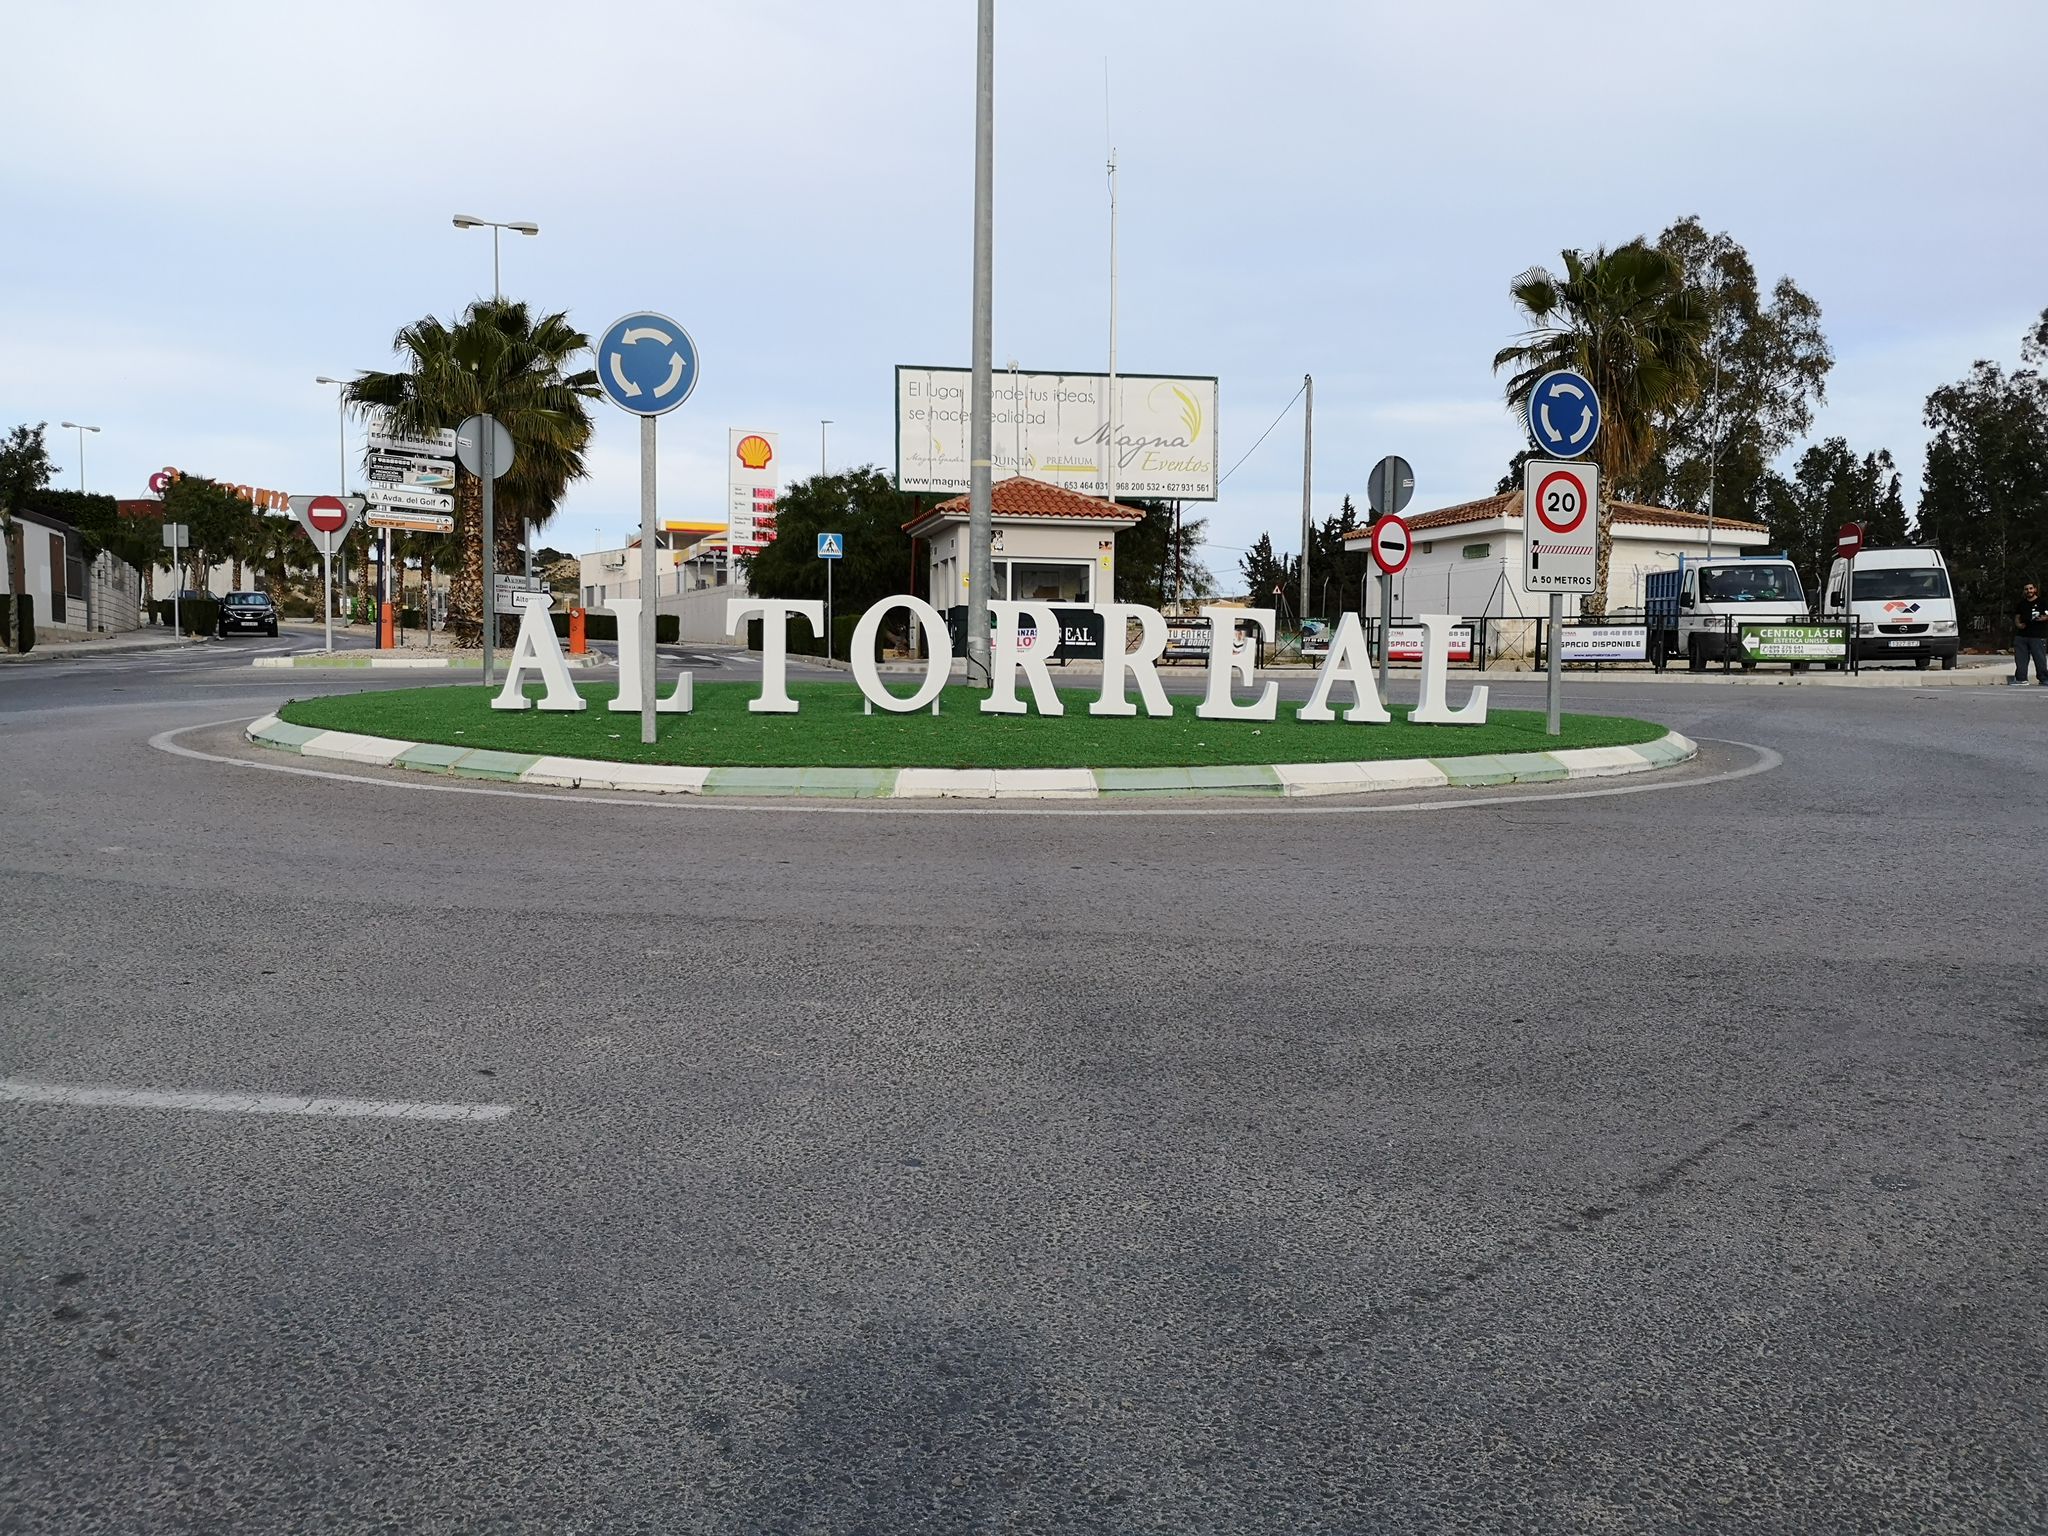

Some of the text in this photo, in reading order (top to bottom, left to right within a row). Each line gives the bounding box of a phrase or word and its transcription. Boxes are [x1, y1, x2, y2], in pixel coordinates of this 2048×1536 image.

[909, 381, 1096, 405] El lugar onde tus ideas,
[908, 408, 1046, 425] se hace ealidad
[1074, 421, 1189, 468] Magna
[1141, 451, 1211, 473] Eventos
[1064, 482, 1078, 490] 653
[1080, 482, 1094, 490] 464
[1116, 483, 1130, 491] 968
[1146, 484, 1160, 492] 532
[1167, 484, 1180, 492] 627
[1181, 484, 1194, 492] 931
[382, 494, 404, 503] Avda.
[1547, 492, 1575, 512] 20
[1532, 575, 1592, 585] A 50 METROS
[1168, 630, 1179, 639] TU
[1760, 627, 1843, 638] CENTRO LÁSER
[1388, 640, 1418, 648] SPACIO
[1592, 640, 1641, 648] DISPONIBLE
